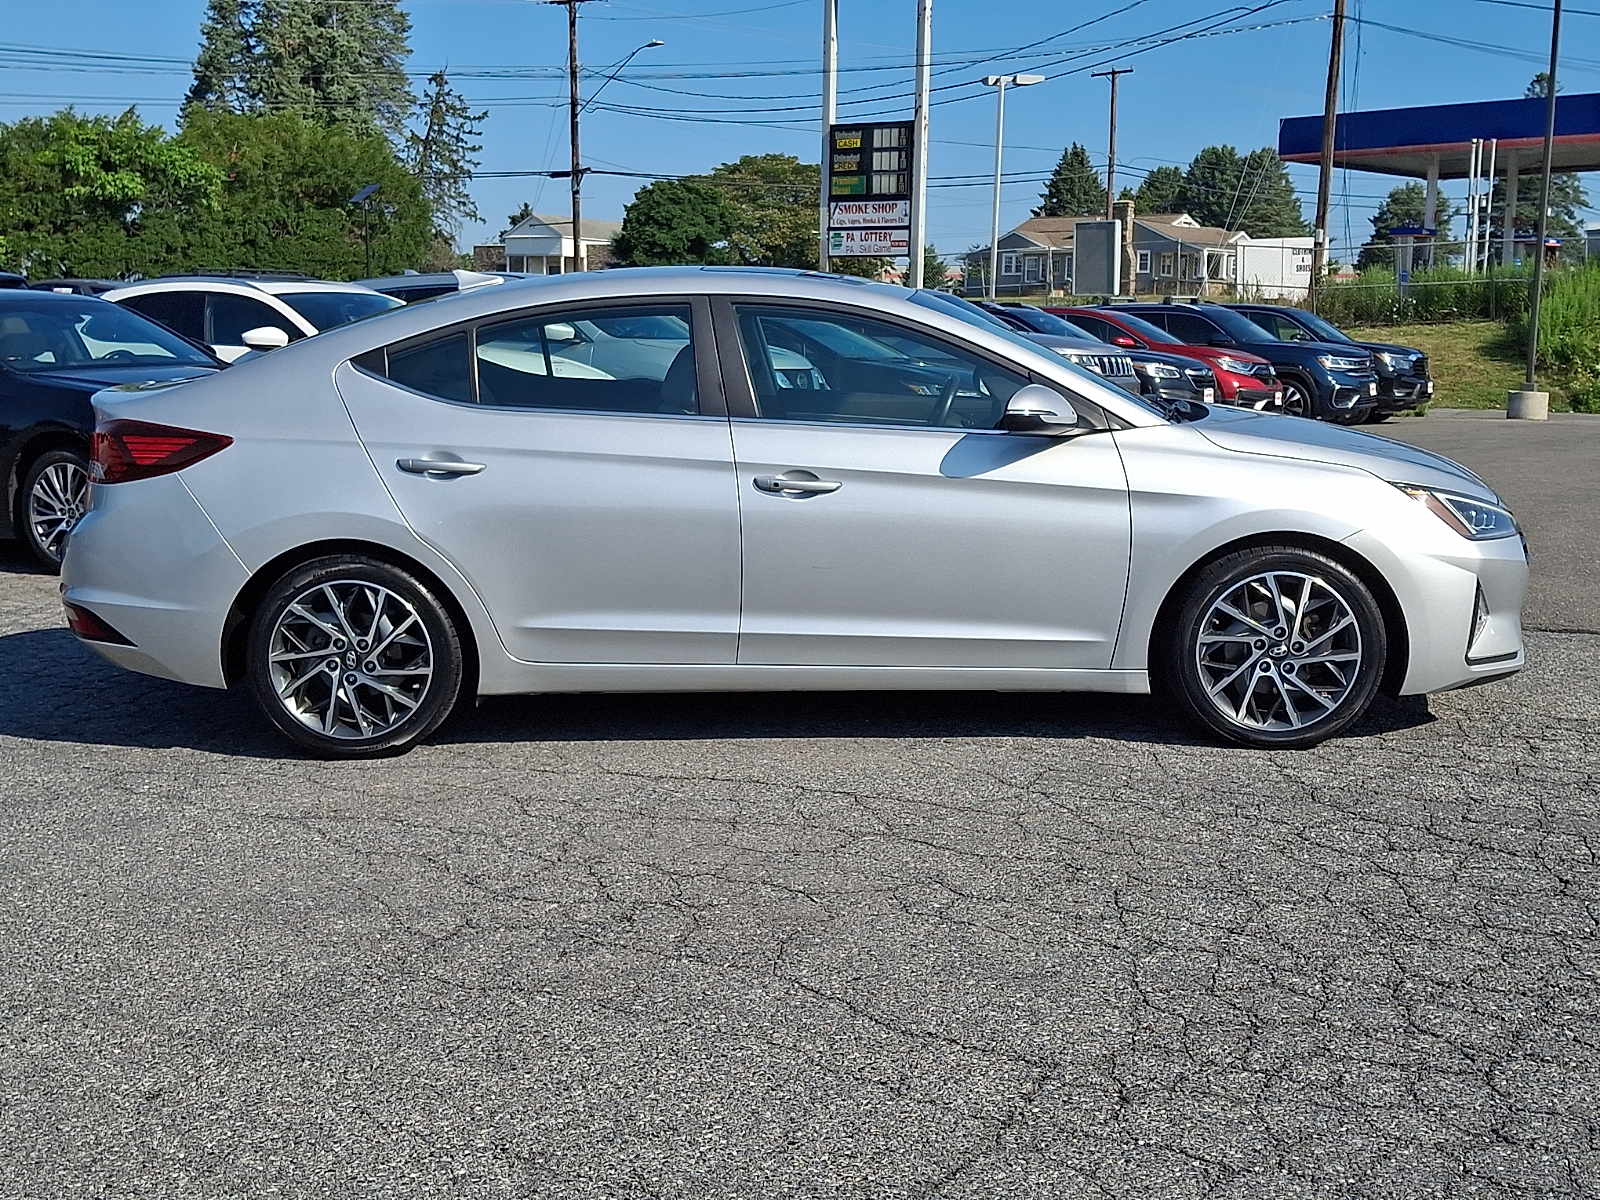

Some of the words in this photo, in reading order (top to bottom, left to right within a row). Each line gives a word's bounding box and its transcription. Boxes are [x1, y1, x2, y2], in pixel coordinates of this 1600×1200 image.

[834, 162, 858, 170] CREDIT
[838, 203, 870, 215] SMOKE
[871, 202, 898, 214] SHOP
[846, 232, 855, 243] PA
[860, 231, 893, 243] LOTTERY
[845, 245, 855, 254] PA
[859, 244, 872, 254] Skill
[873, 244, 892, 253] Game
